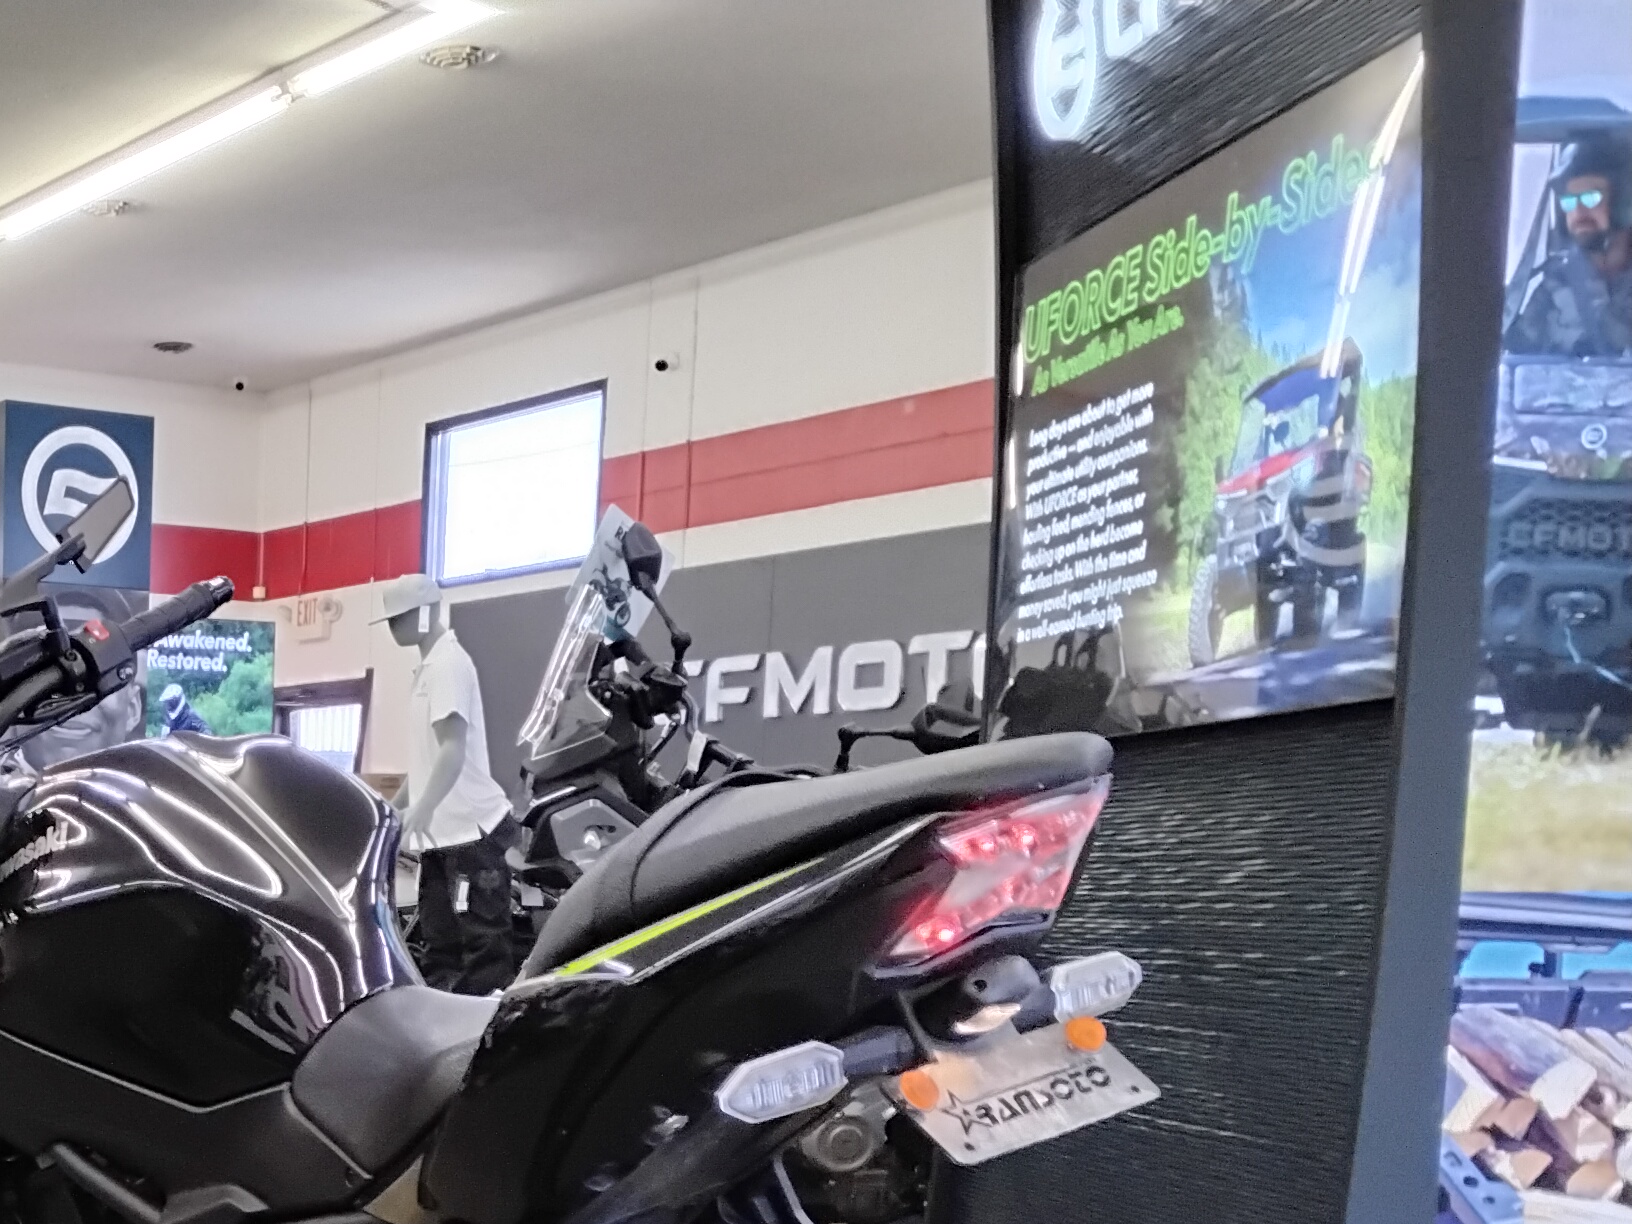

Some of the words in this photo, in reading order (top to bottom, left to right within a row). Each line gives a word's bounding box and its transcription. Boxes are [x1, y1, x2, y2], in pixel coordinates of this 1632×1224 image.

[1023, 243, 1144, 364] UFORCE
[1142, 132, 1382, 302] Side-by-Side
[297, 597, 319, 627] EXIT
[147, 649, 228, 673] Restored.
[682, 629, 987, 723] FMOT
